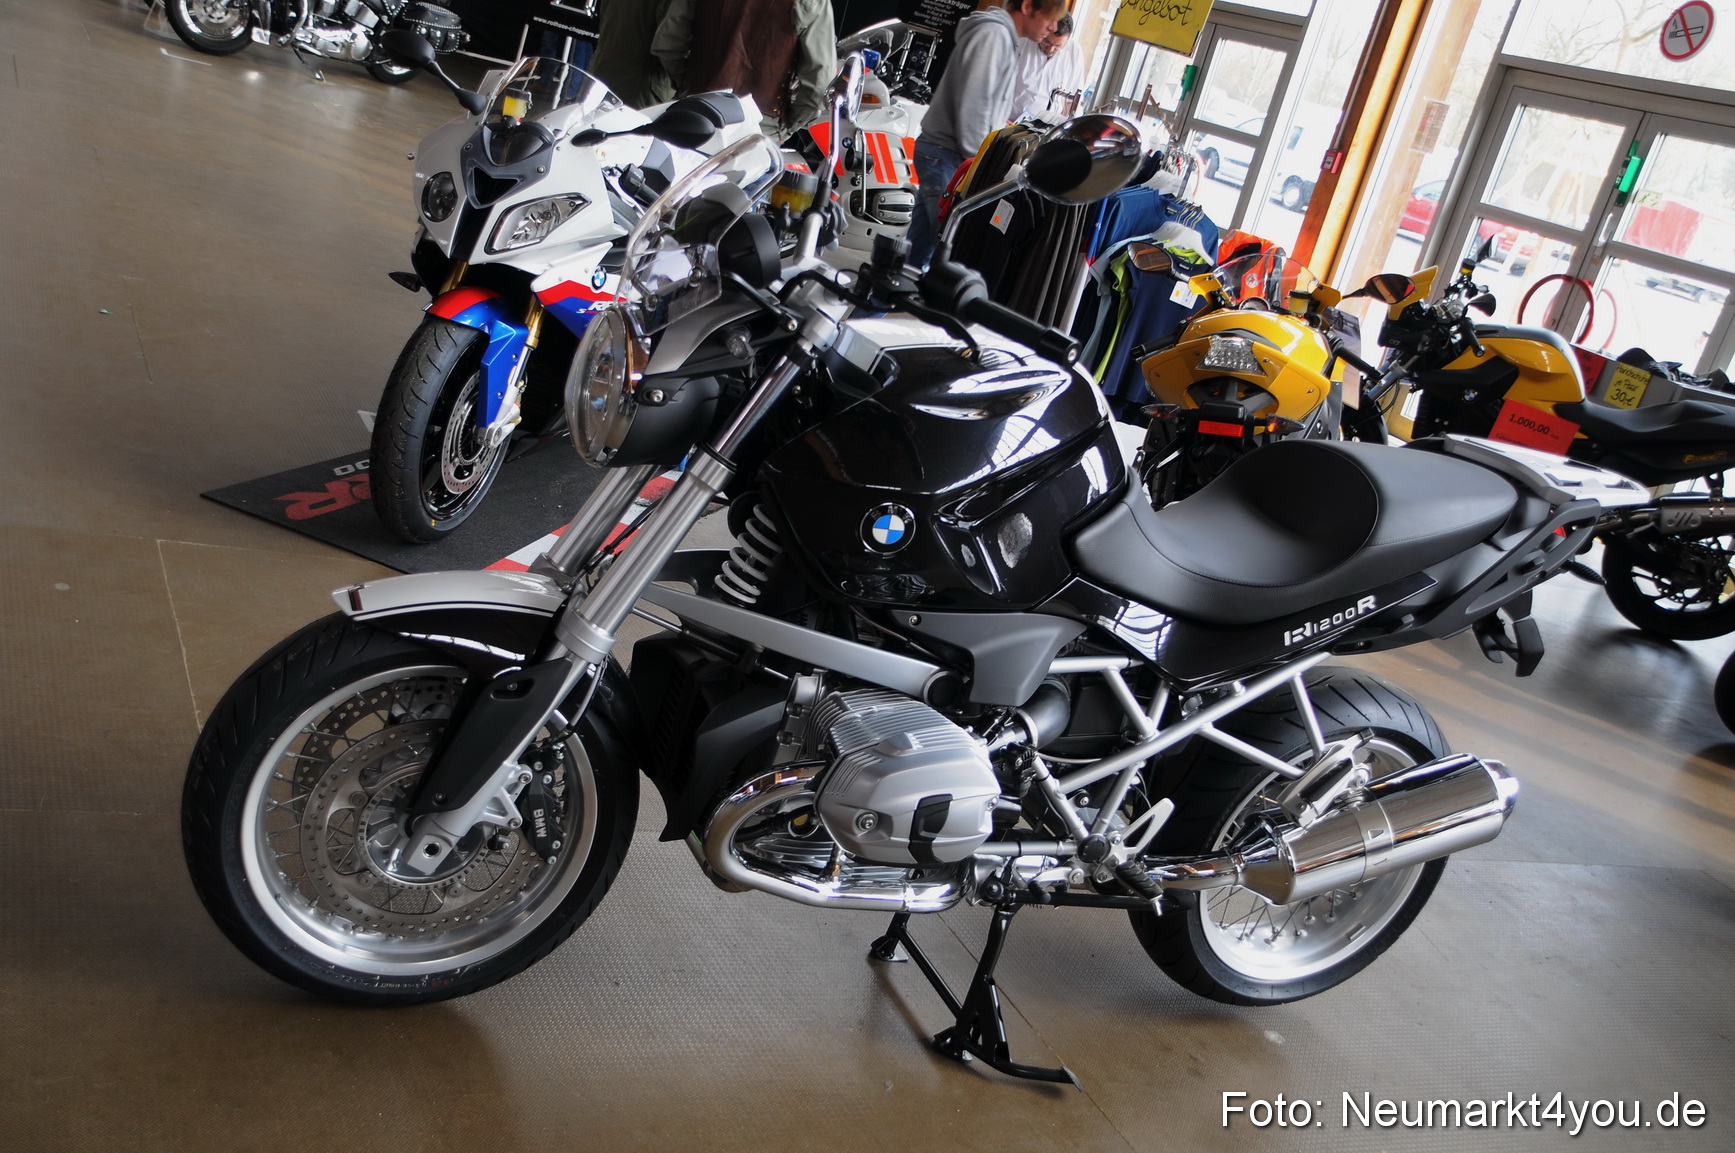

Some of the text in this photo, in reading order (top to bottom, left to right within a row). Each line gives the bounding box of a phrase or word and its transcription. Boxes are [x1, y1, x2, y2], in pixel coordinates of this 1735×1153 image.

[533, 16, 600, 39] www.rothsee-choppers.d
[1508, 413, 1550, 434] 1.000,00
[533, 808, 548, 838] BMW
